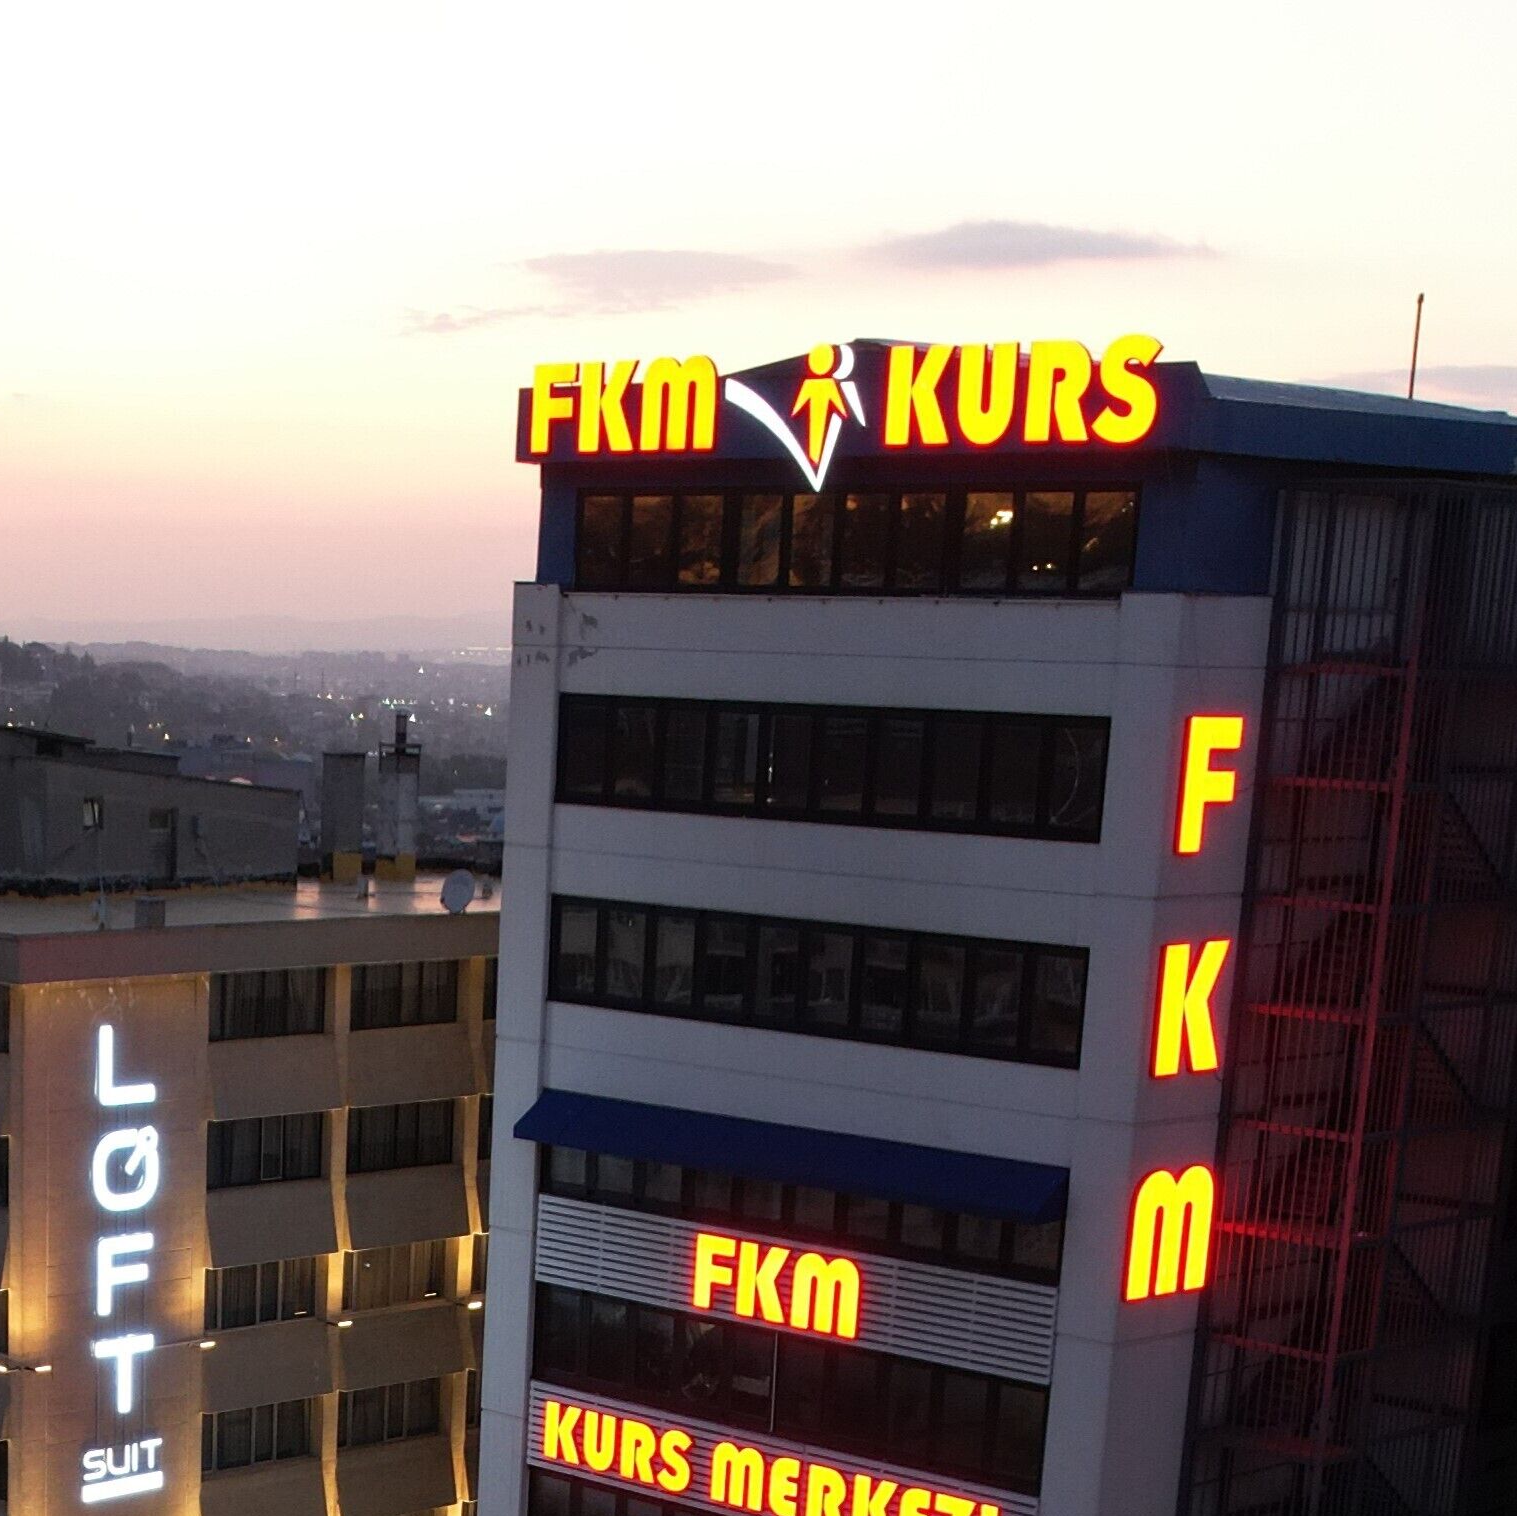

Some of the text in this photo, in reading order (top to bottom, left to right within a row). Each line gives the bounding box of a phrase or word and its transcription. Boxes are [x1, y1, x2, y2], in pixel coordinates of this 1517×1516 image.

[529, 334, 1164, 456] FKM KURS
[1124, 715, 1244, 1302] FKM
[90, 1024, 158, 1414] LOFT
[692, 1231, 861, 1341] FKM
[83, 1438, 163, 1481] SUIT
[542, 1400, 694, 1494] KURS
